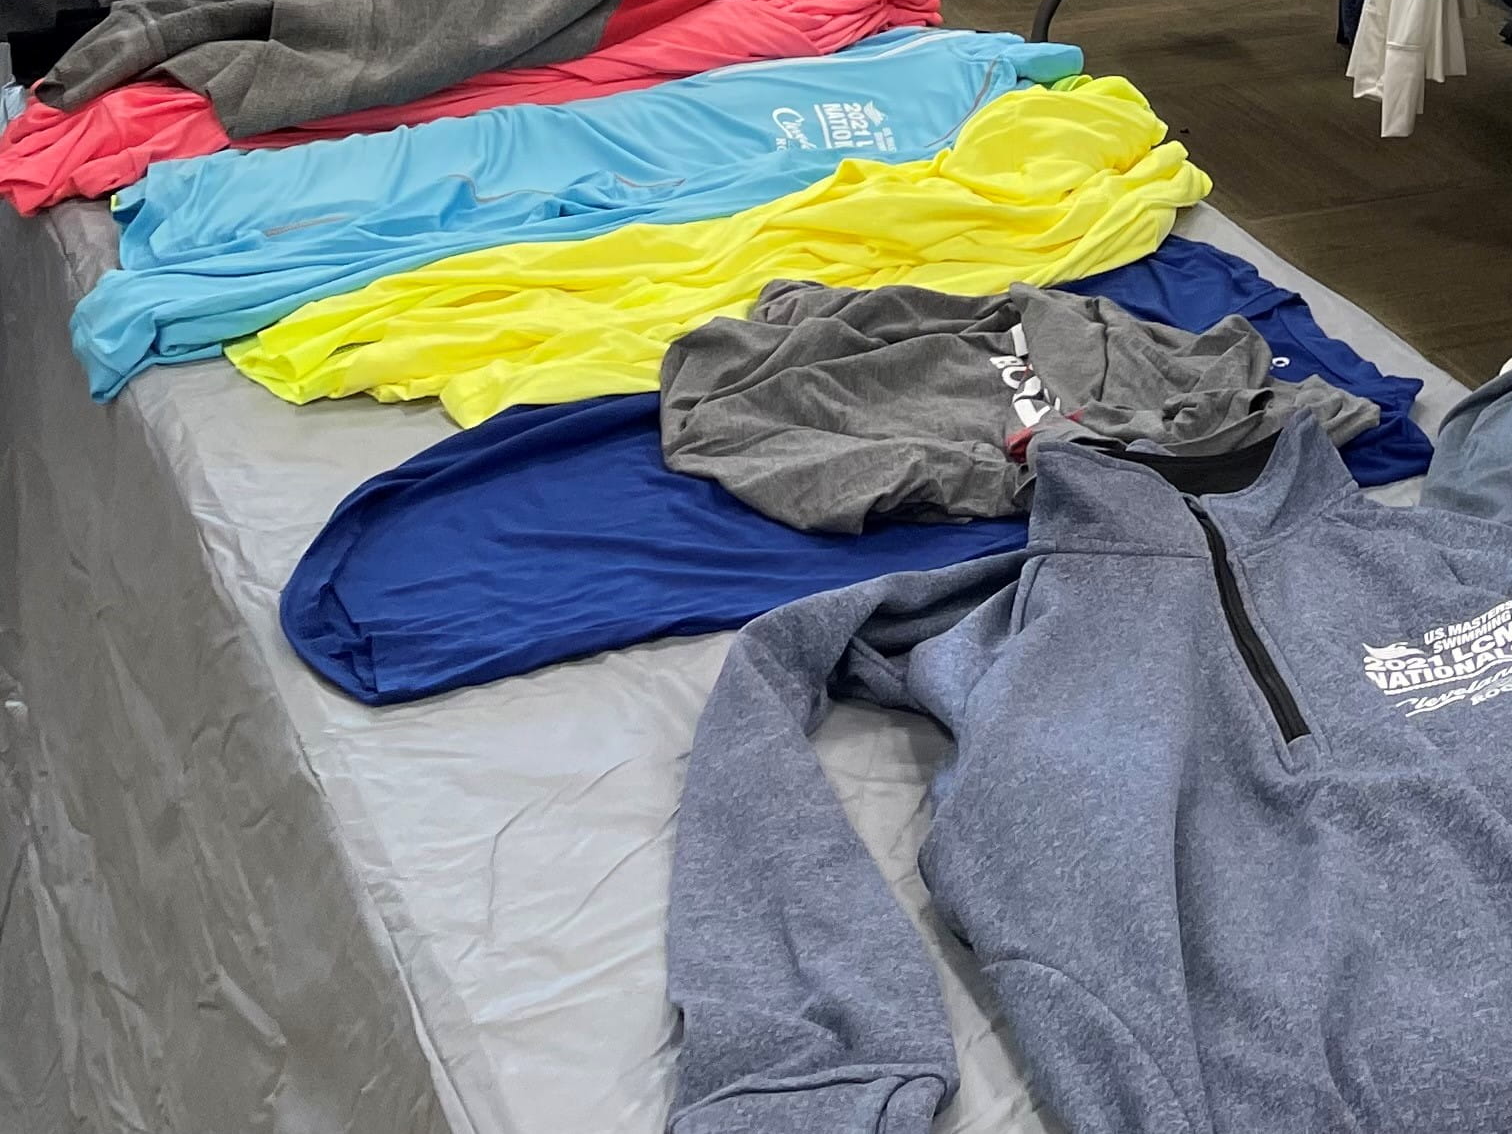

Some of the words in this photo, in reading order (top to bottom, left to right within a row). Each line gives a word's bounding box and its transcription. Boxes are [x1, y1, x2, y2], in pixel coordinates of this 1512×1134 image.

[843, 102, 871, 137] 2021
[1433, 610, 1512, 654] SWIMMING
[1363, 654, 1444, 672] 2021
